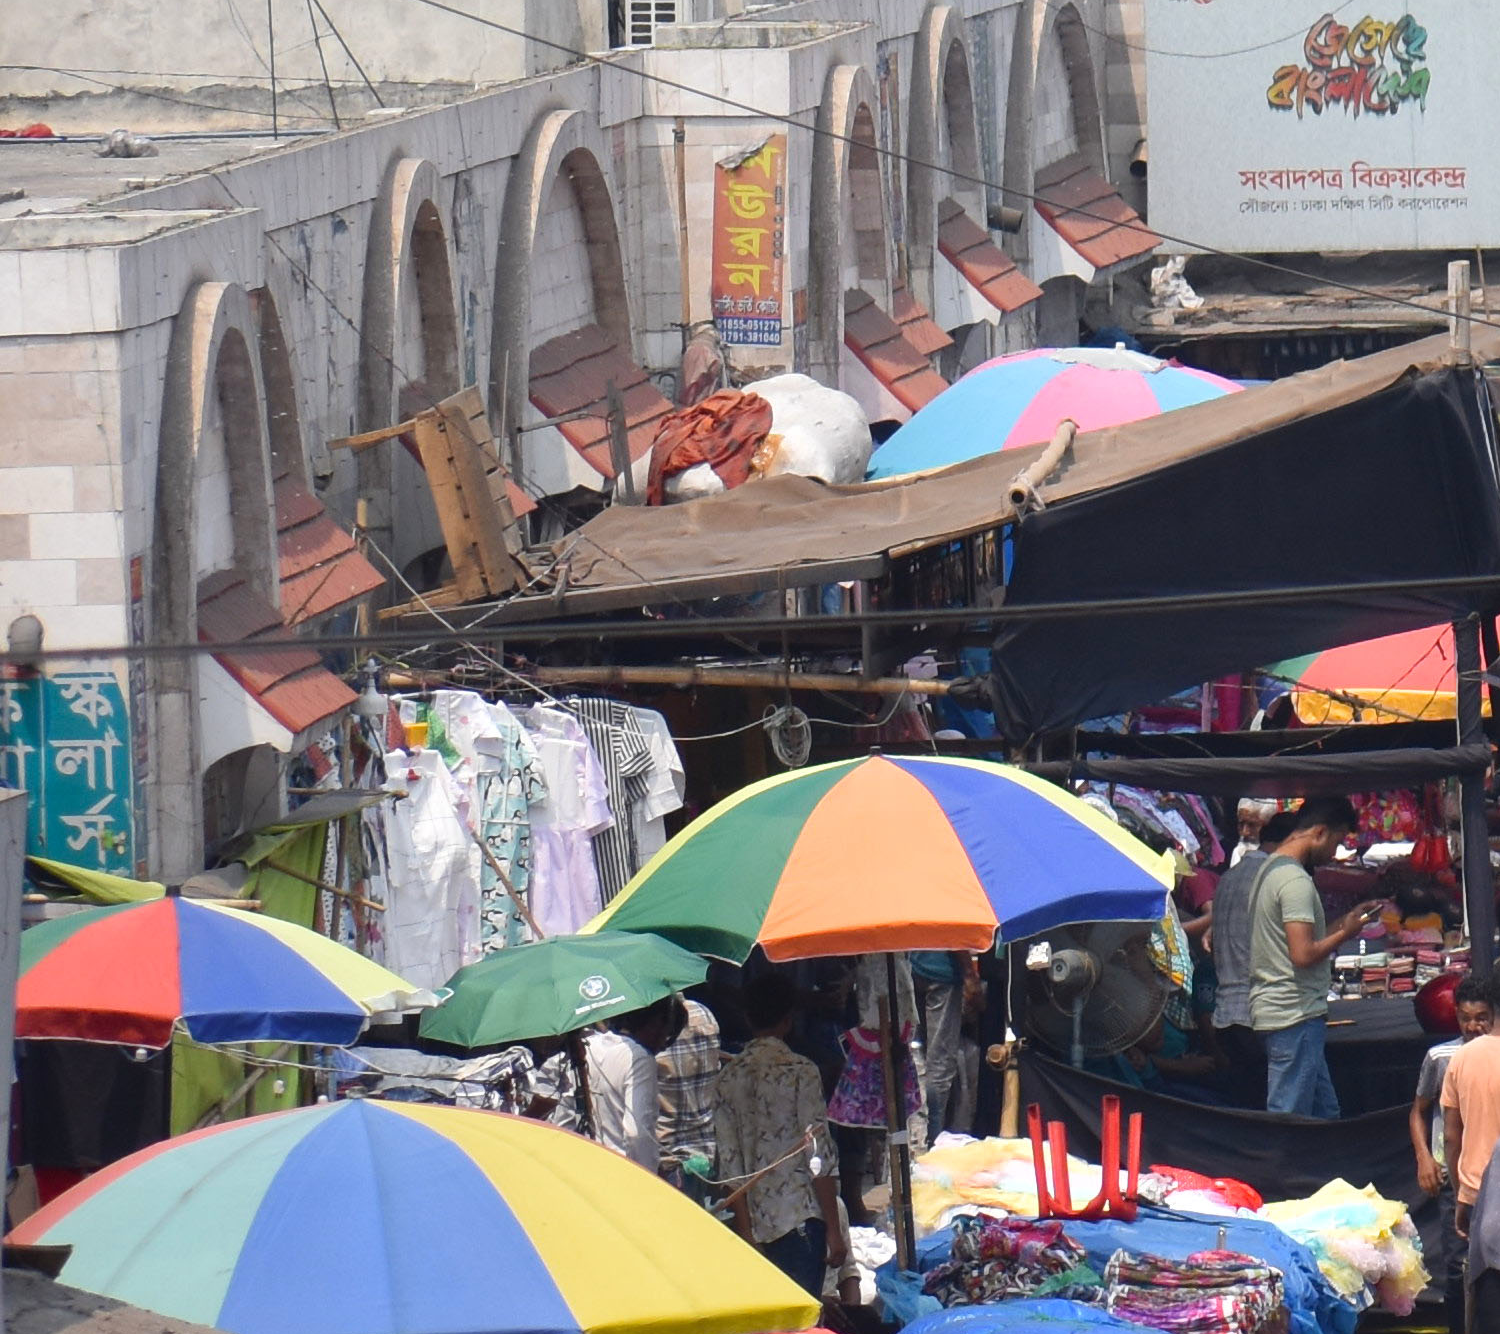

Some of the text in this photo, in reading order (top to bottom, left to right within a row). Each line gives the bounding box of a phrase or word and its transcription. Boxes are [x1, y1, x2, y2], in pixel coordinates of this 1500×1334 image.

[1266, 63, 1432, 120] বাংলাদেশ
[1238, 161, 1467, 191] সংবাদপত্র বিক্রয়কেন্দ্র
[1301, 198, 1328, 213] ঢাকা
